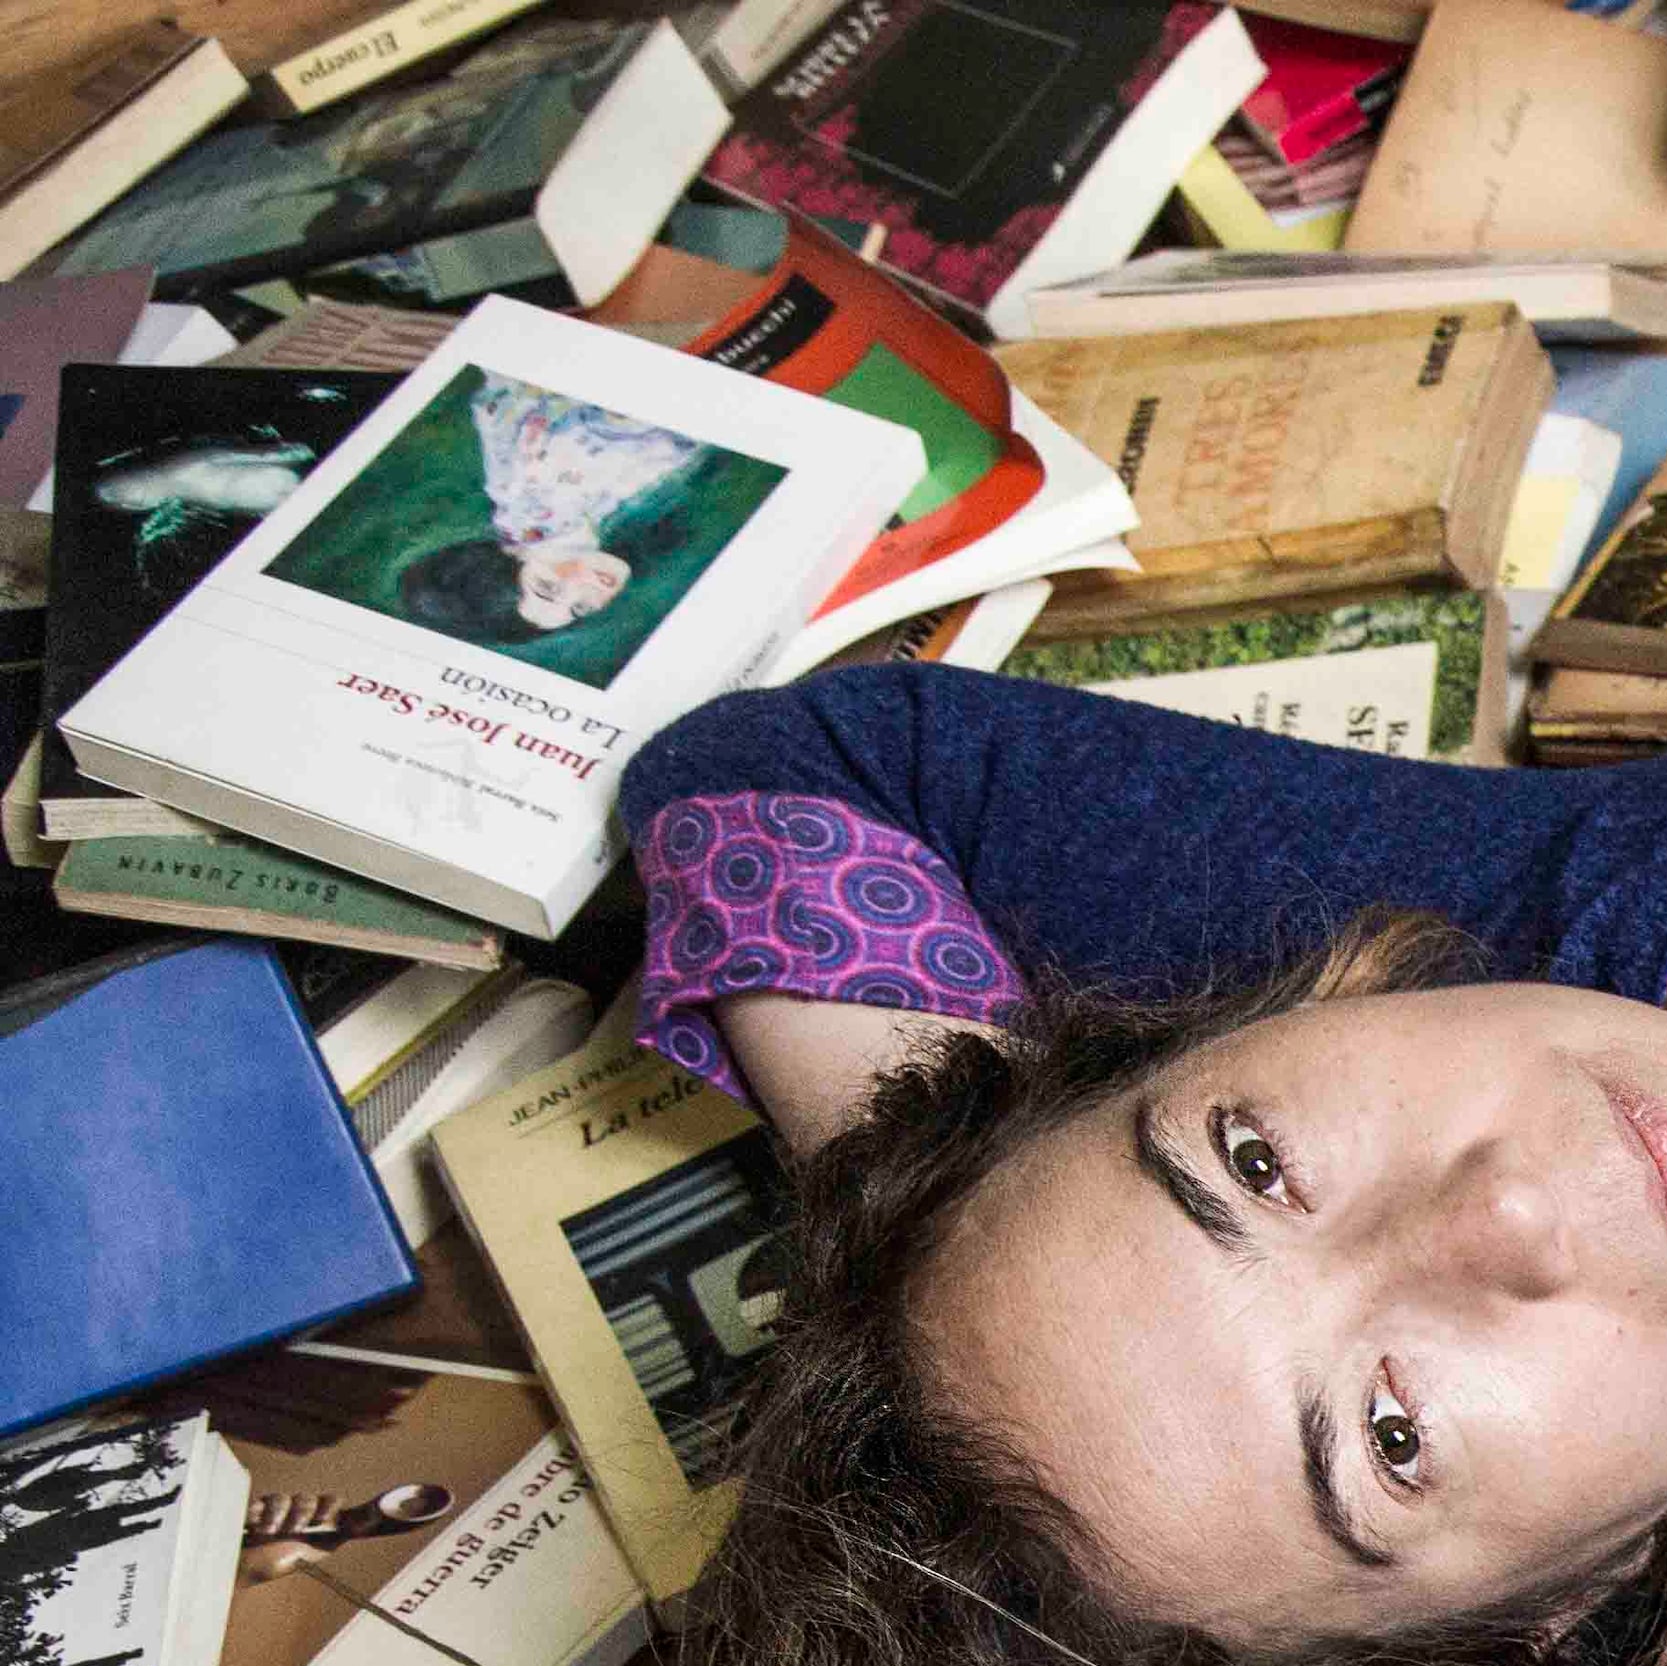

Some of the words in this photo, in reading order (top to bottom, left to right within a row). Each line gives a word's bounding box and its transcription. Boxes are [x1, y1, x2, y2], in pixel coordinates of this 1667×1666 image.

[335, 672, 424, 716] Saer
[440, 665, 572, 724] ocasión
[423, 701, 512, 745] José
[581, 716, 626, 750] La
[514, 730, 602, 780] Juan
[484, 1502, 521, 1531] de
[470, 1510, 565, 1589] Zeiger
[396, 1533, 484, 1614] guerra
